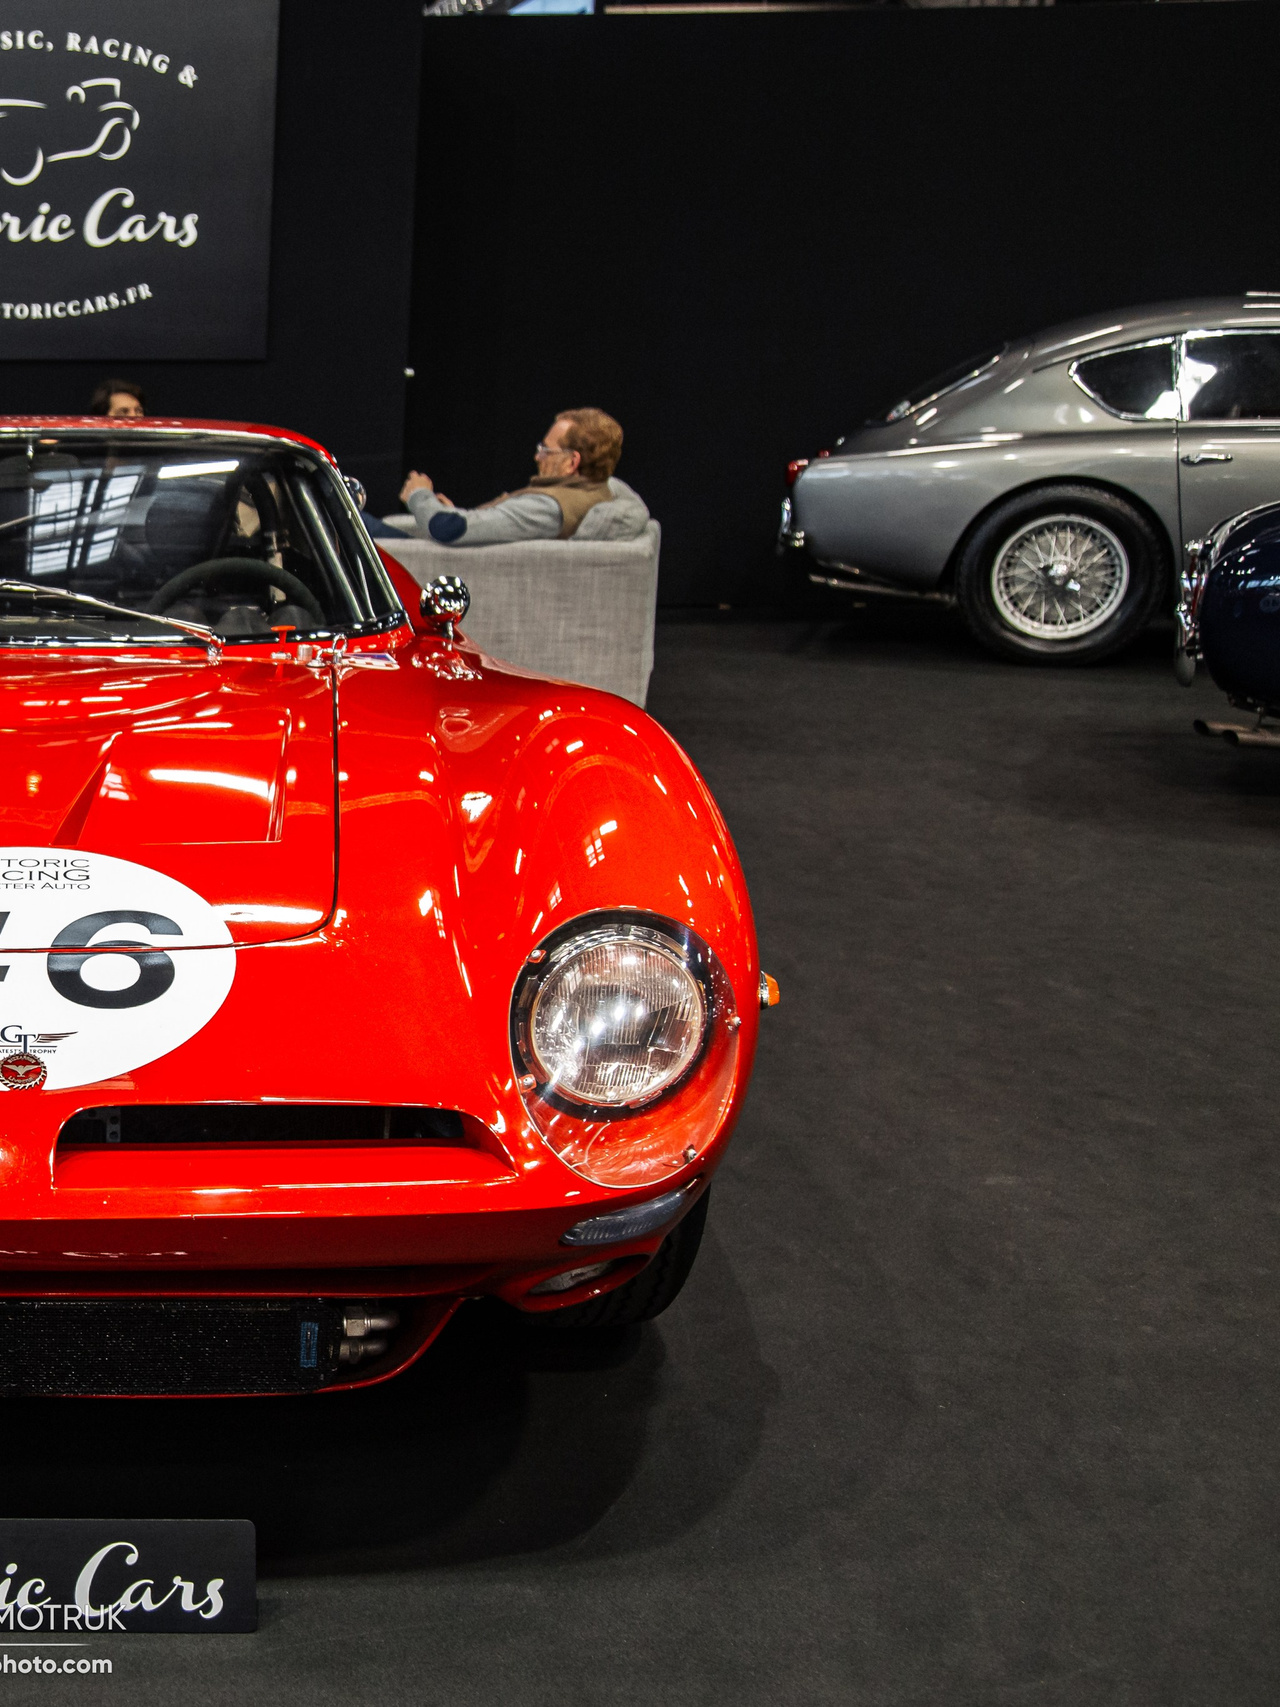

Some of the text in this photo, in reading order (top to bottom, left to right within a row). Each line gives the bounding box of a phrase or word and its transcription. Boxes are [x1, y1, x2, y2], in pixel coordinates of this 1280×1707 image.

[66, 32, 170, 75] RACING
[177, 65, 199, 89] &
[82, 187, 199, 248] Cars
[0, 1025, 36, 1053] GT
[74, 1542, 225, 1619] Cars
